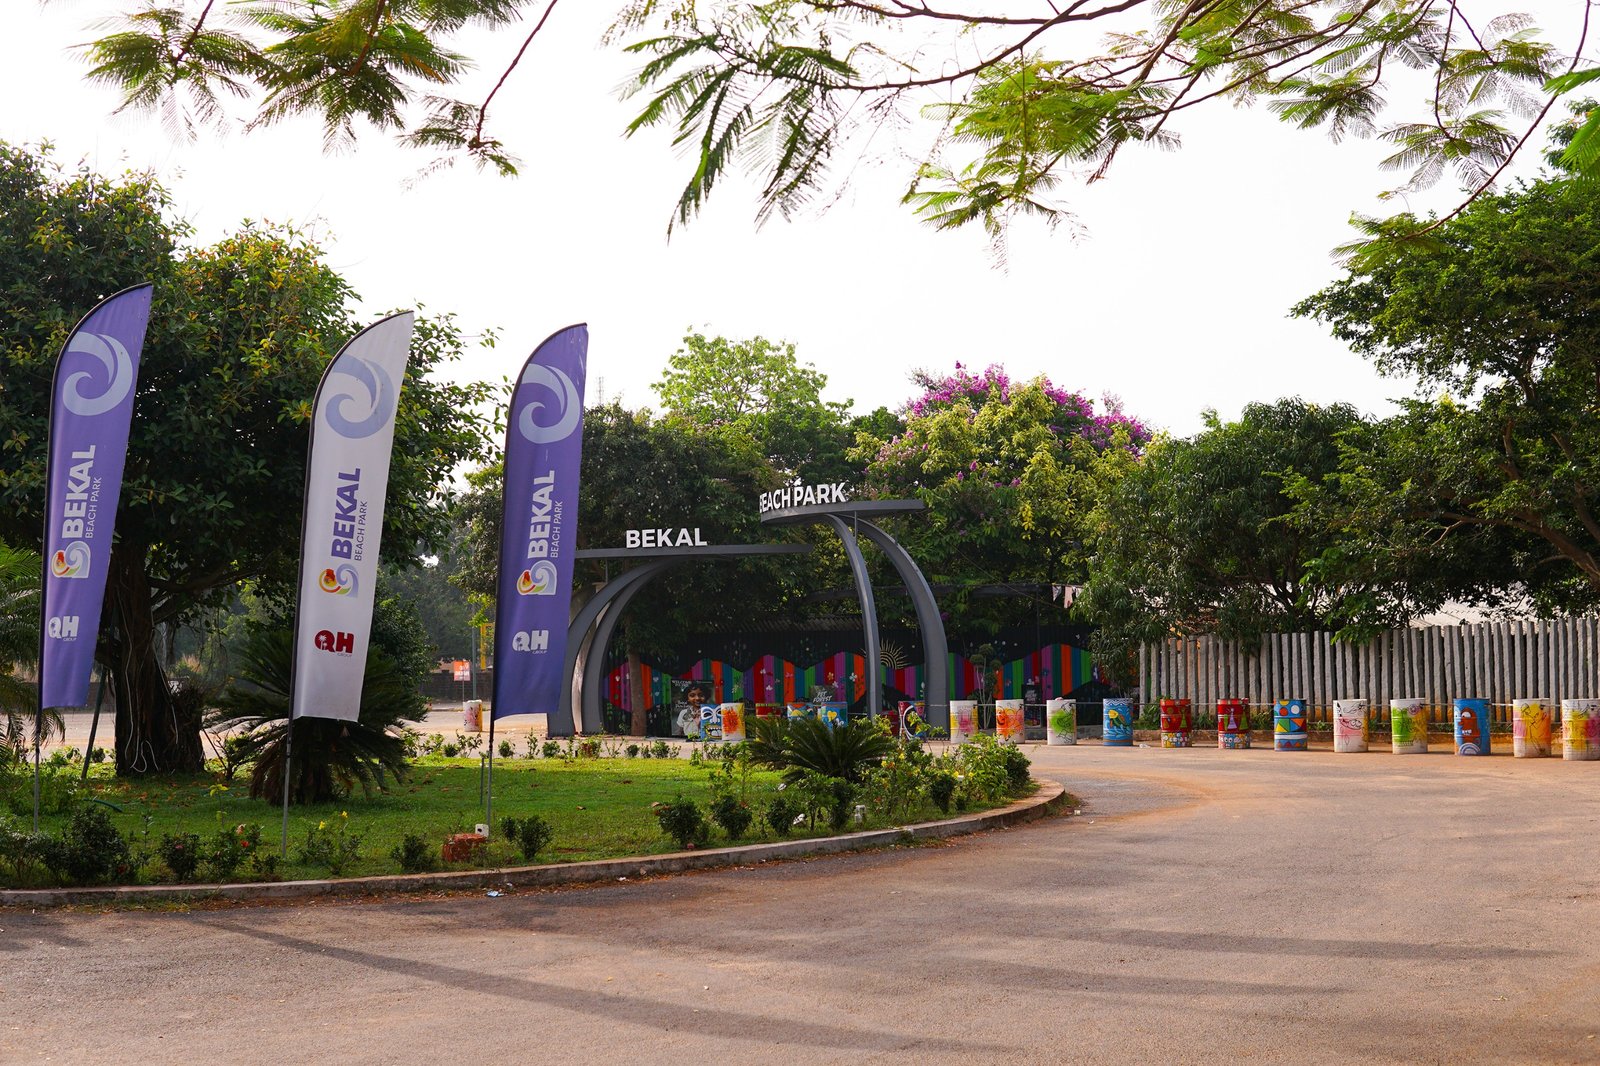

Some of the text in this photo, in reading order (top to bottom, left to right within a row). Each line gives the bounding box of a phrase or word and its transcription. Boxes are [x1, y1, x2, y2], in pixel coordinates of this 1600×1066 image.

[62, 445, 96, 539] BEKAL
[85, 476, 102, 539] BEACH PARK
[331, 468, 361, 560] BEKAL
[527, 470, 555, 559] BEKAL
[793, 482, 846, 507] PARK
[354, 500, 368, 561] BEACH PARK
[551, 500, 564, 558] BEACH PARK
[625, 527, 708, 549] BEKAL
[48, 615, 80, 639] QH
[314, 629, 355, 654] QH
[512, 629, 549, 651] QH
